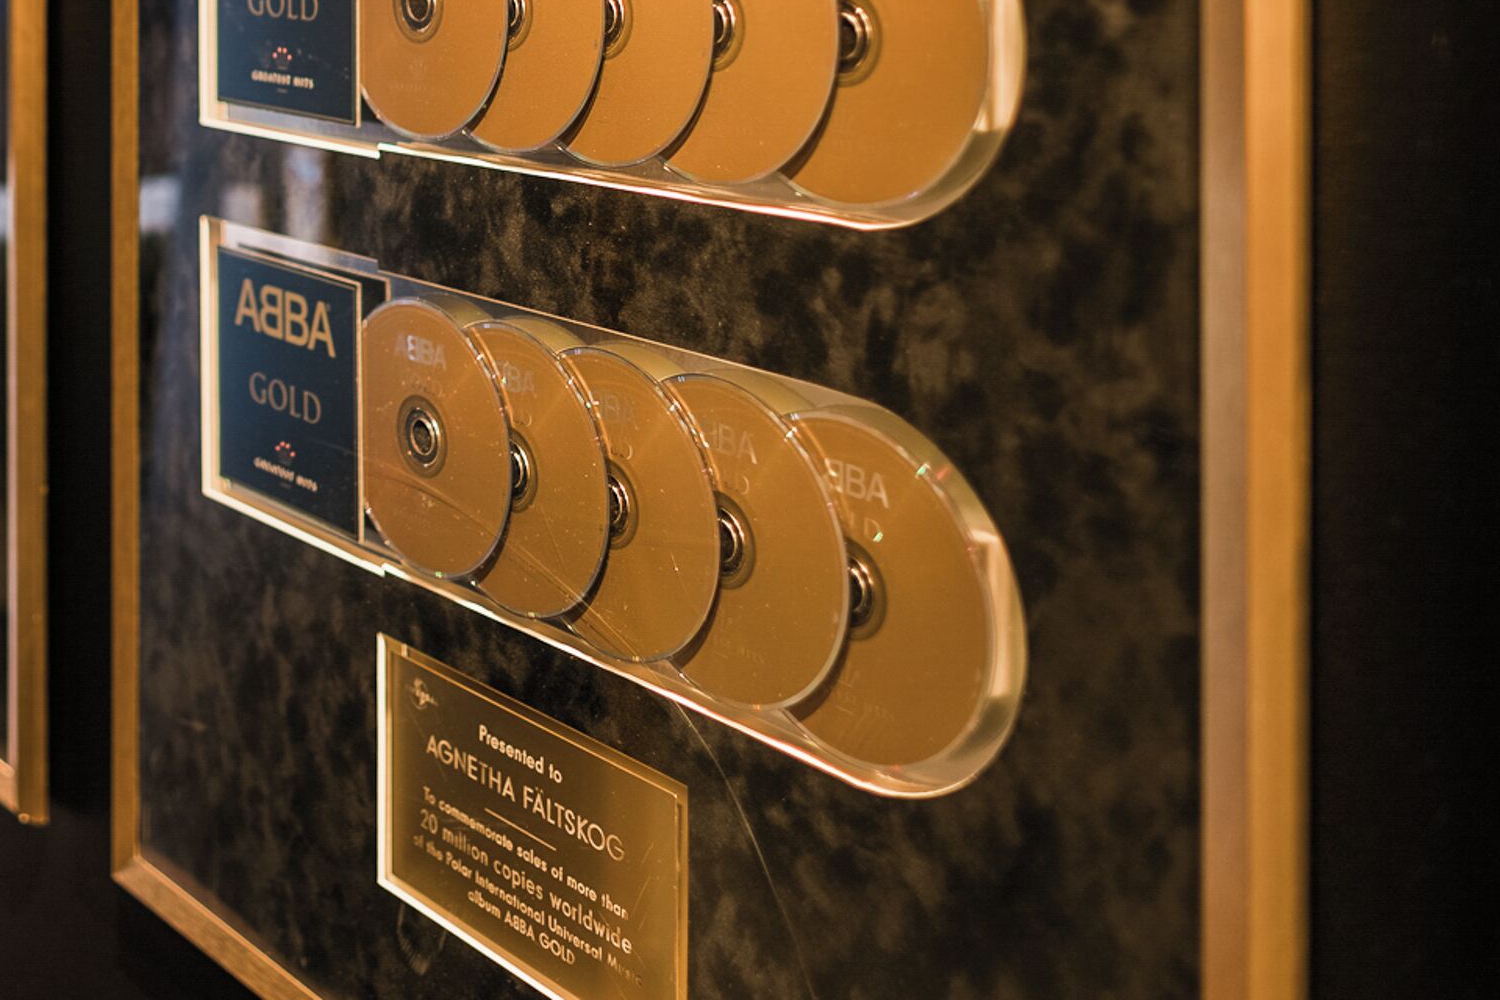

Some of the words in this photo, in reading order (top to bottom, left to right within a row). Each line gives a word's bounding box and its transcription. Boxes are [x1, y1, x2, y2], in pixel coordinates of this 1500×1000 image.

[234, 278, 336, 358] ABBA
[249, 372, 322, 425] GOLD
[826, 458, 889, 508] BBA
[478, 724, 543, 771] Presented
[549, 763, 563, 784] to
[426, 735, 515, 802] AGNETHA
[523, 785, 624, 861] FÄLTSKOG
[420, 809, 438, 833] 20
[442, 826, 488, 867] million
[494, 859, 543, 901] copies
[549, 891, 632, 954] worldwide
[423, 787, 437, 802] To
[439, 799, 513, 852] commemorate
[517, 846, 547, 873] sales
[551, 865, 563, 882] of
[567, 875, 597, 902] more
[601, 893, 628, 920] than
[426, 841, 443, 862] the
[446, 853, 472, 880] Polar
[475, 870, 546, 926] International
[548, 917, 603, 961] Universal
[467, 890, 501, 919] album
[504, 909, 535, 942] ABBA
[539, 932, 575, 965] GOLD
